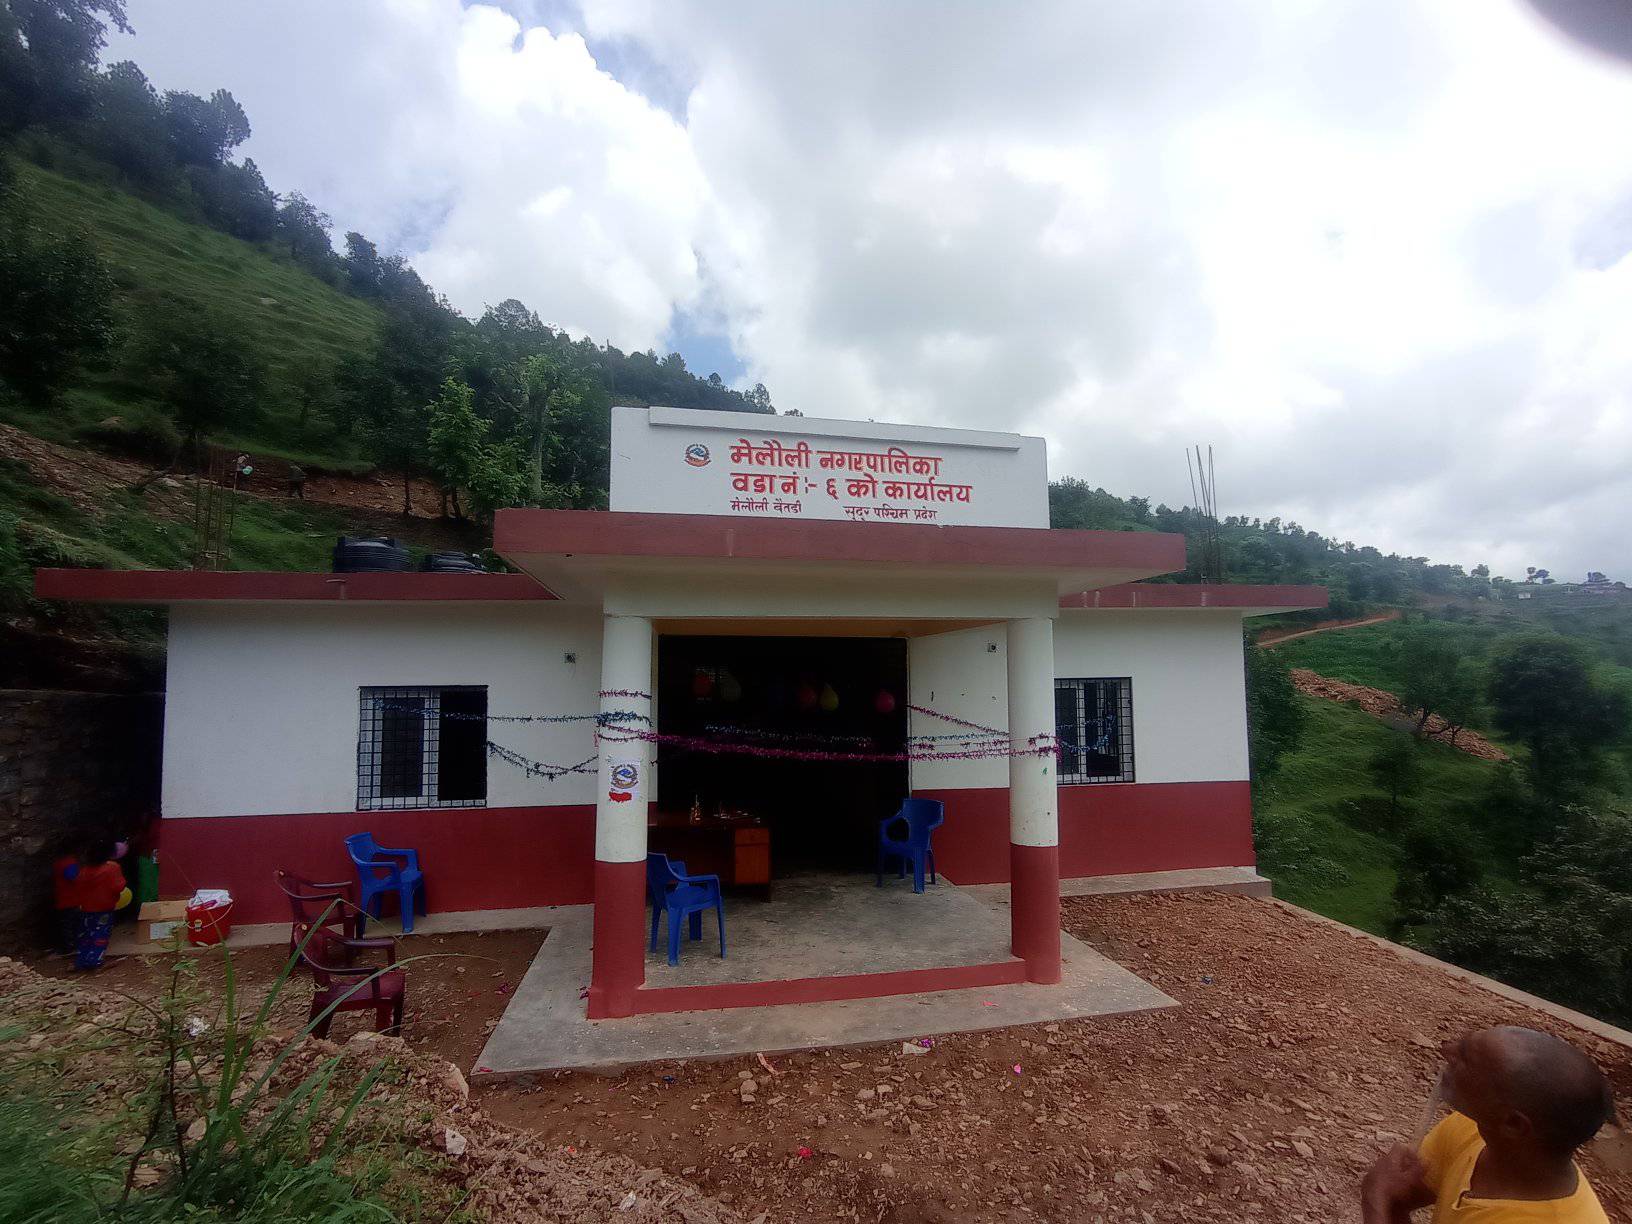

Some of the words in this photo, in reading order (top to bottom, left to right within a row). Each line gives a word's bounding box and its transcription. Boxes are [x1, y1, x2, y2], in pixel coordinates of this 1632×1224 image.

[816, 447, 943, 475] नगरपालिका
[730, 472, 777, 494] वडा
[826, 478, 839, 500] ६
[845, 472, 878, 498] को
[882, 476, 973, 503] कार्यालय
[911, 505, 937, 520] प्रदेश
